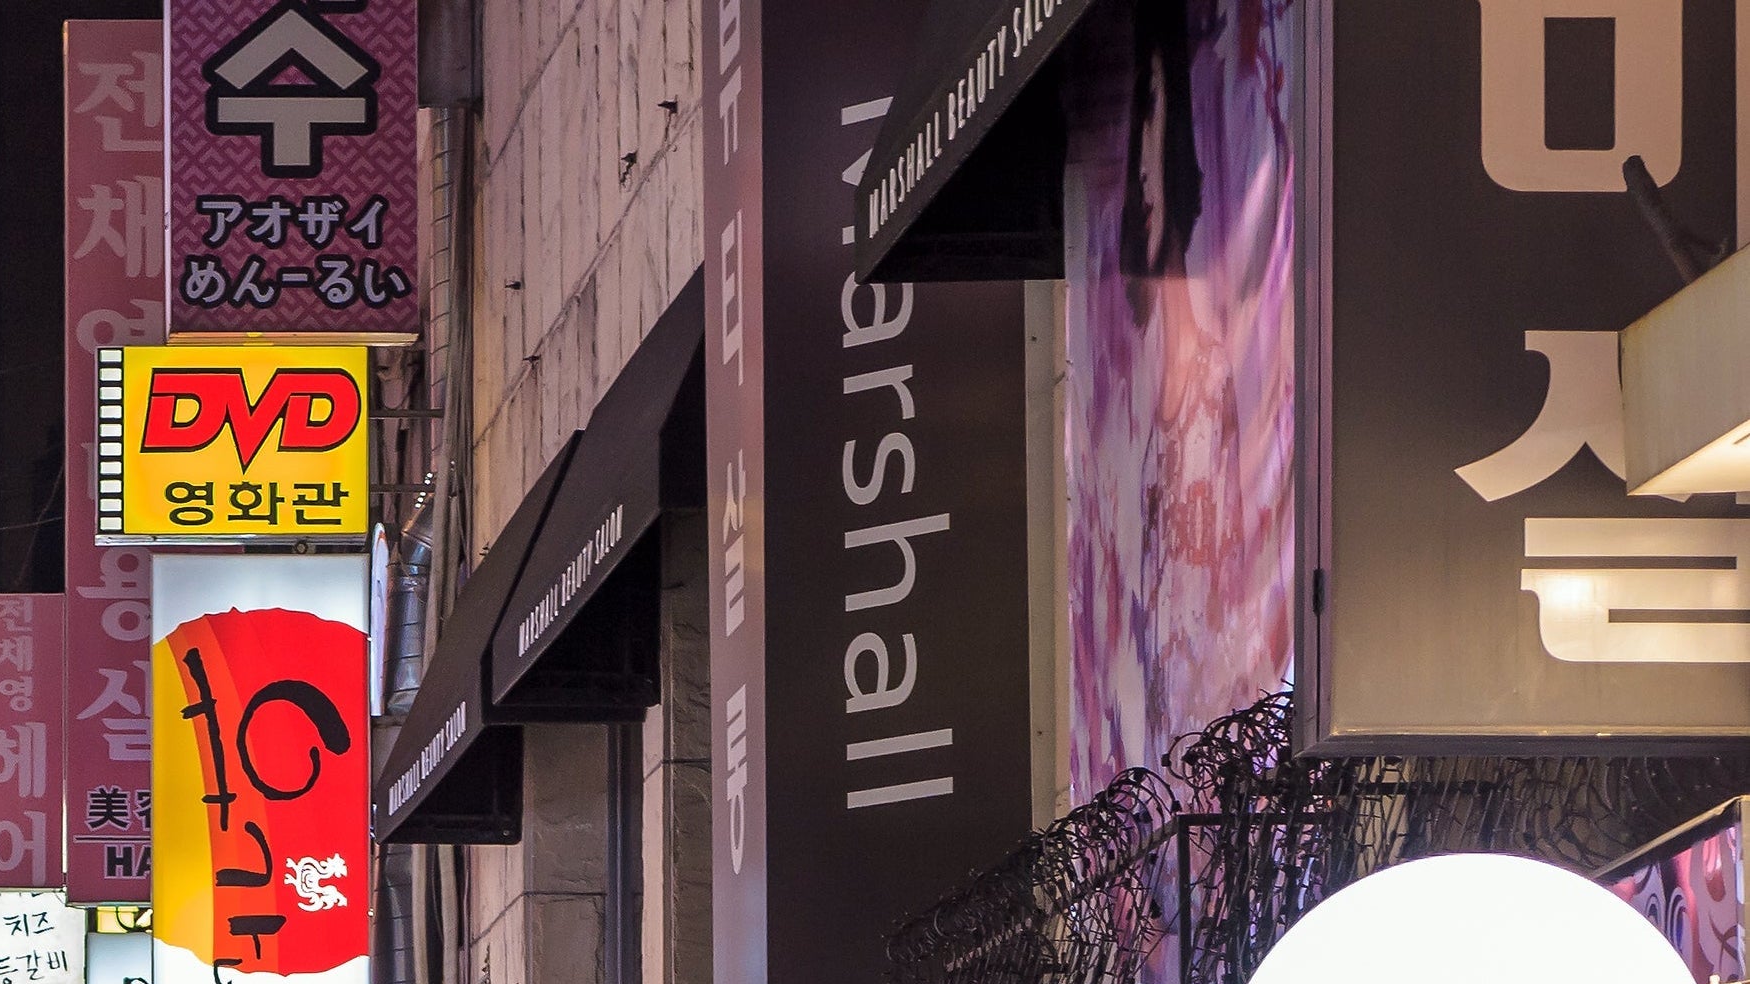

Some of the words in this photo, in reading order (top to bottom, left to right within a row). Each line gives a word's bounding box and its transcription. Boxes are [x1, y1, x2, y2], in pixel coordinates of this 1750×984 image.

[868, 111, 943, 239] MARSHALL
[947, 25, 1007, 141] BEAUTY
[201, 198, 388, 246] アオザイ
[140, 367, 362, 476] DVD
[841, 96, 955, 811] arshall
[163, 481, 350, 527] 영화관
[518, 583, 559, 657] MARSHALL
[561, 539, 594, 607] BEAUTY
[594, 503, 624, 565] SALON
[3, 912, 56, 938] 치즈
